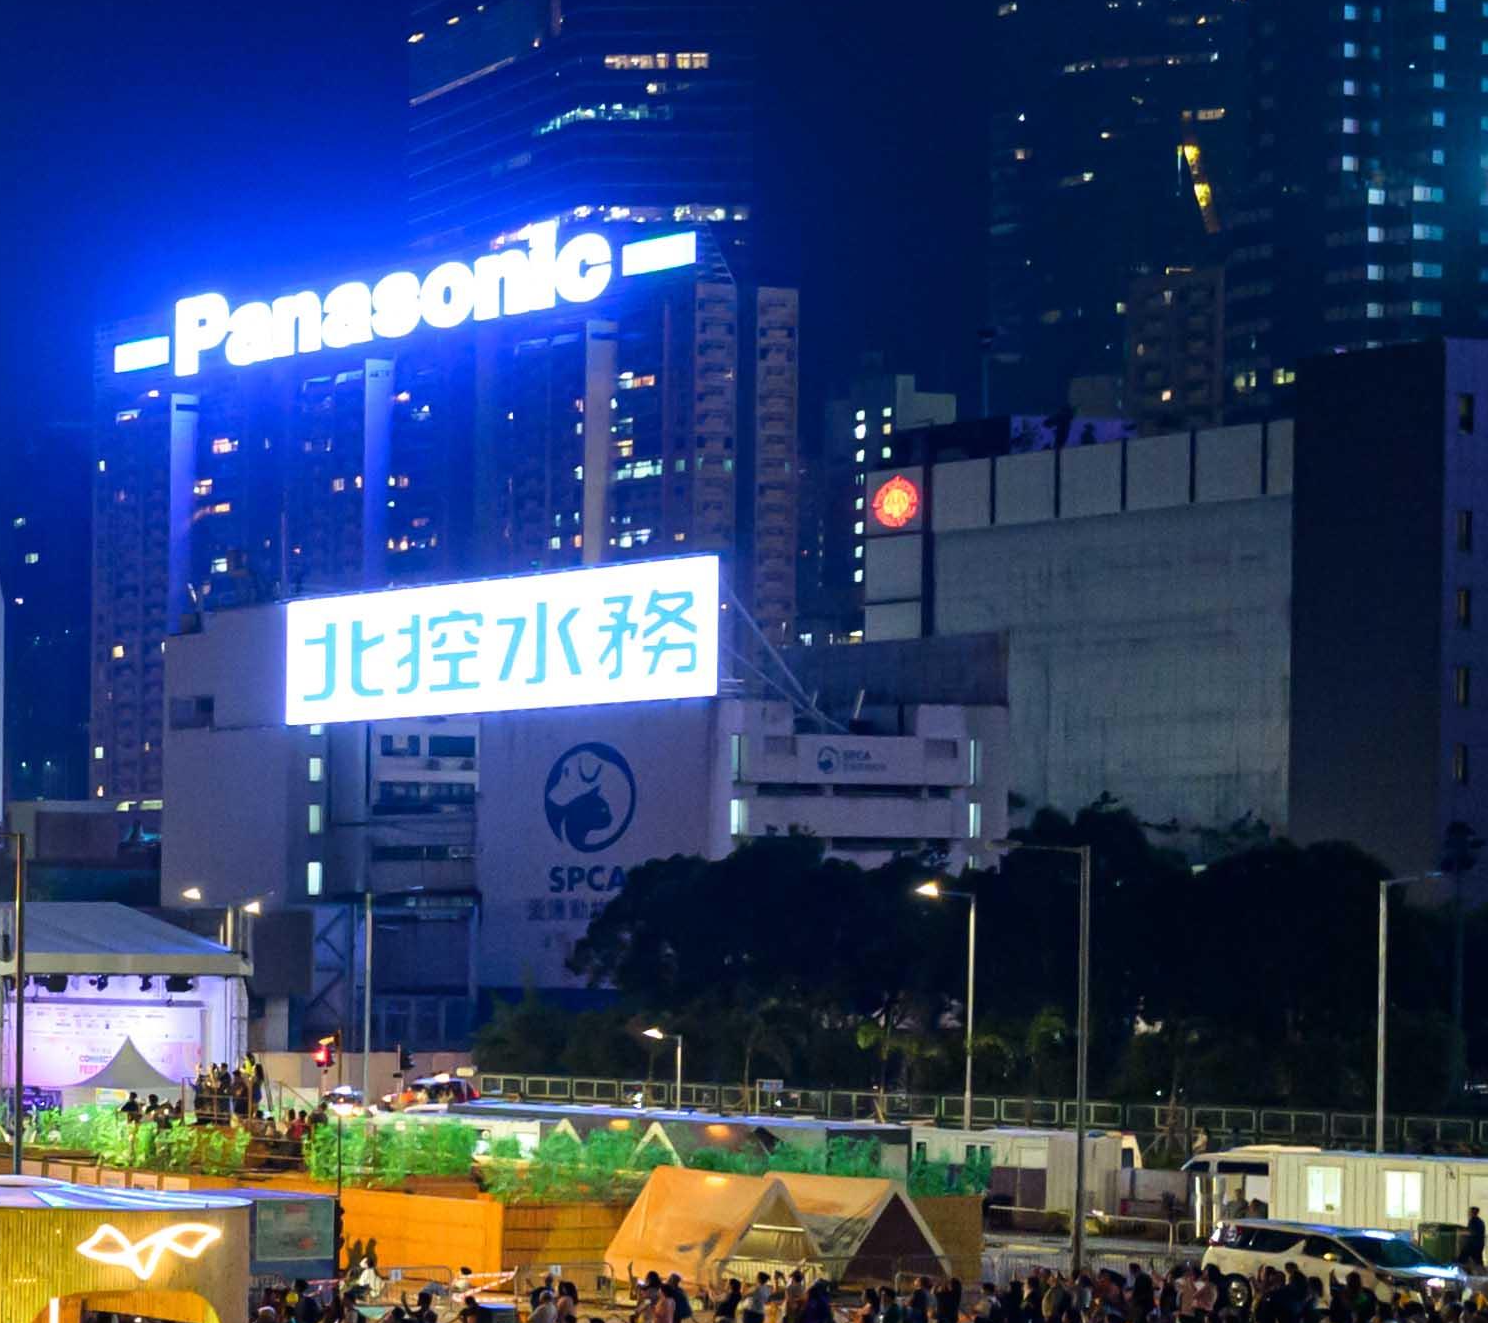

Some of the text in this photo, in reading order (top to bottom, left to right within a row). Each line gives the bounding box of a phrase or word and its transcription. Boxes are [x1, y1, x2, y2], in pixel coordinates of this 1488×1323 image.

[173, 218, 614, 378] Panasonic
[301, 587, 699, 703] 北控水務
[548, 865, 627, 893] SPCA
